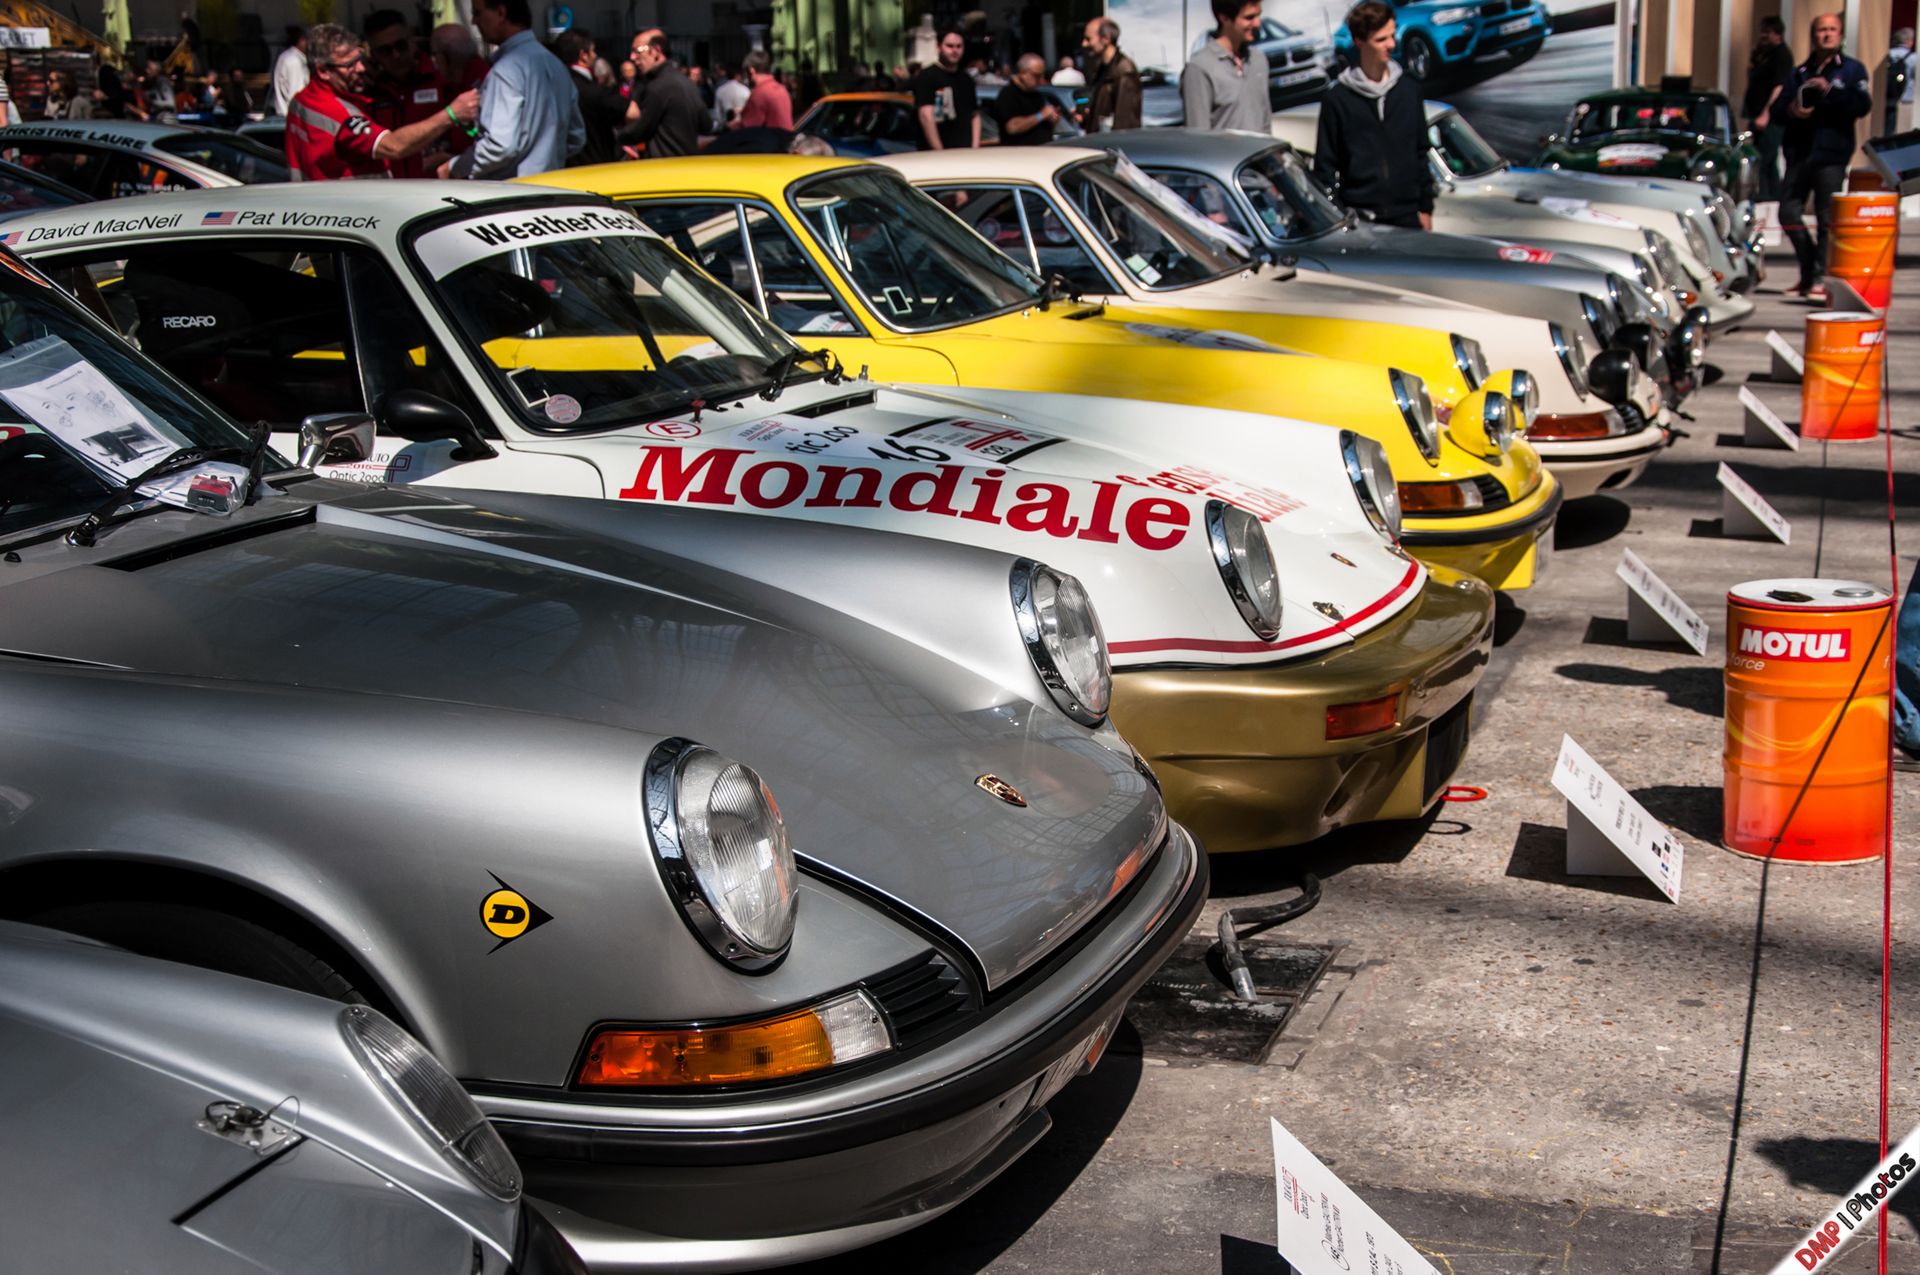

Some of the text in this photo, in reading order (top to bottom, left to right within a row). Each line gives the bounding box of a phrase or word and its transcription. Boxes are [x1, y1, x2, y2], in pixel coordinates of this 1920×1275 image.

[88, 130, 148, 150] LAURE
[27, 213, 183, 242] David MacNeil
[237, 211, 381, 230] Pat Womack
[464, 211, 648, 246] WeatherTech
[162, 314, 217, 329] RECARO
[618, 445, 1191, 551] Mondiale
[1740, 628, 1847, 659] MOTUL
[487, 903, 526, 925] D
